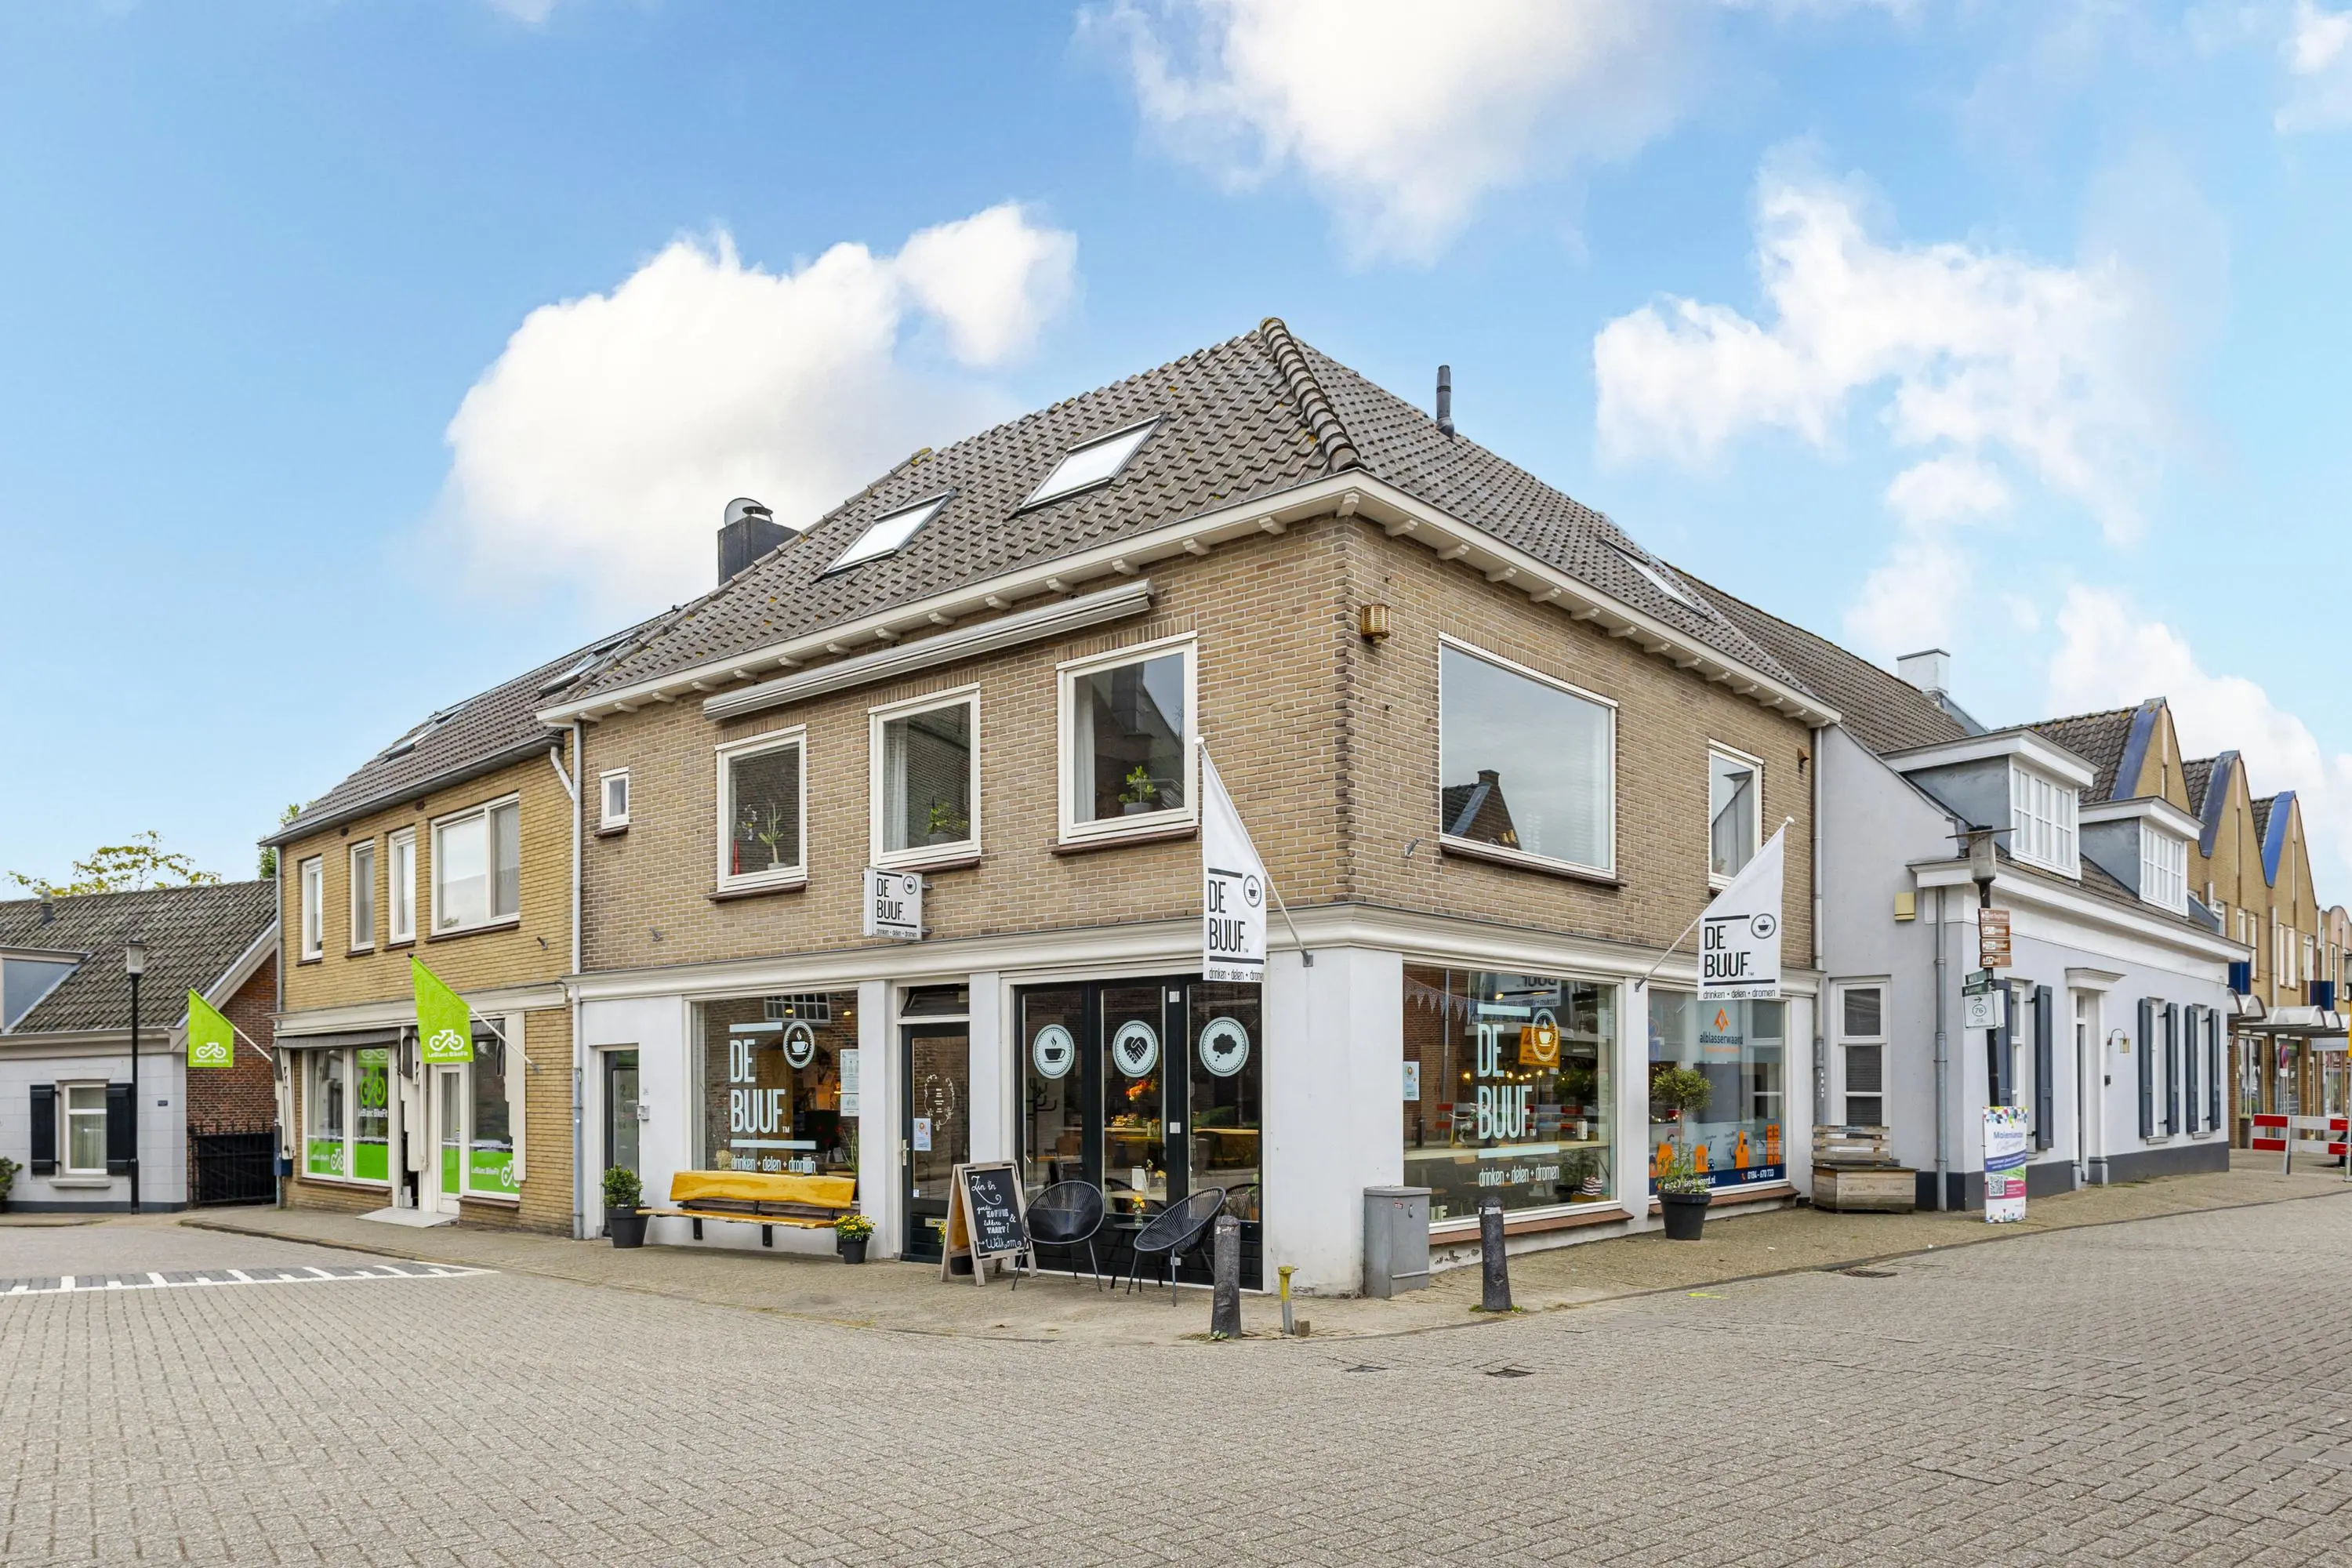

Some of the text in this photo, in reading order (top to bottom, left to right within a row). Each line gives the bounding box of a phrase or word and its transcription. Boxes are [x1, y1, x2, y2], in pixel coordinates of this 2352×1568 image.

[877, 878, 889, 898] DE
[1208, 880, 1226, 913] DE
[877, 899, 903, 920] BUUF
[1209, 917, 1246, 953] BUUF
[1704, 925, 1726, 950] DE
[1209, 967, 1227, 979] drinken
[1230, 969, 1244, 980] delen
[1704, 952, 1751, 978] BUUF
[1703, 989, 1776, 1000] drinken delen dromen
[1477, 1024, 1504, 1077] DE
[1699, 1031, 1744, 1045] alblasserwaard
[729, 1039, 756, 1083] DE
[730, 1089, 786, 1134] BUUF
[1478, 1085, 1533, 1140] BUUF
[731, 1155, 756, 1171] drinken
[763, 1156, 782, 1172] delen
[1479, 1167, 1504, 1187] drinken
[1511, 1165, 1530, 1184] delen
[1535, 1163, 1559, 1181] dromen
